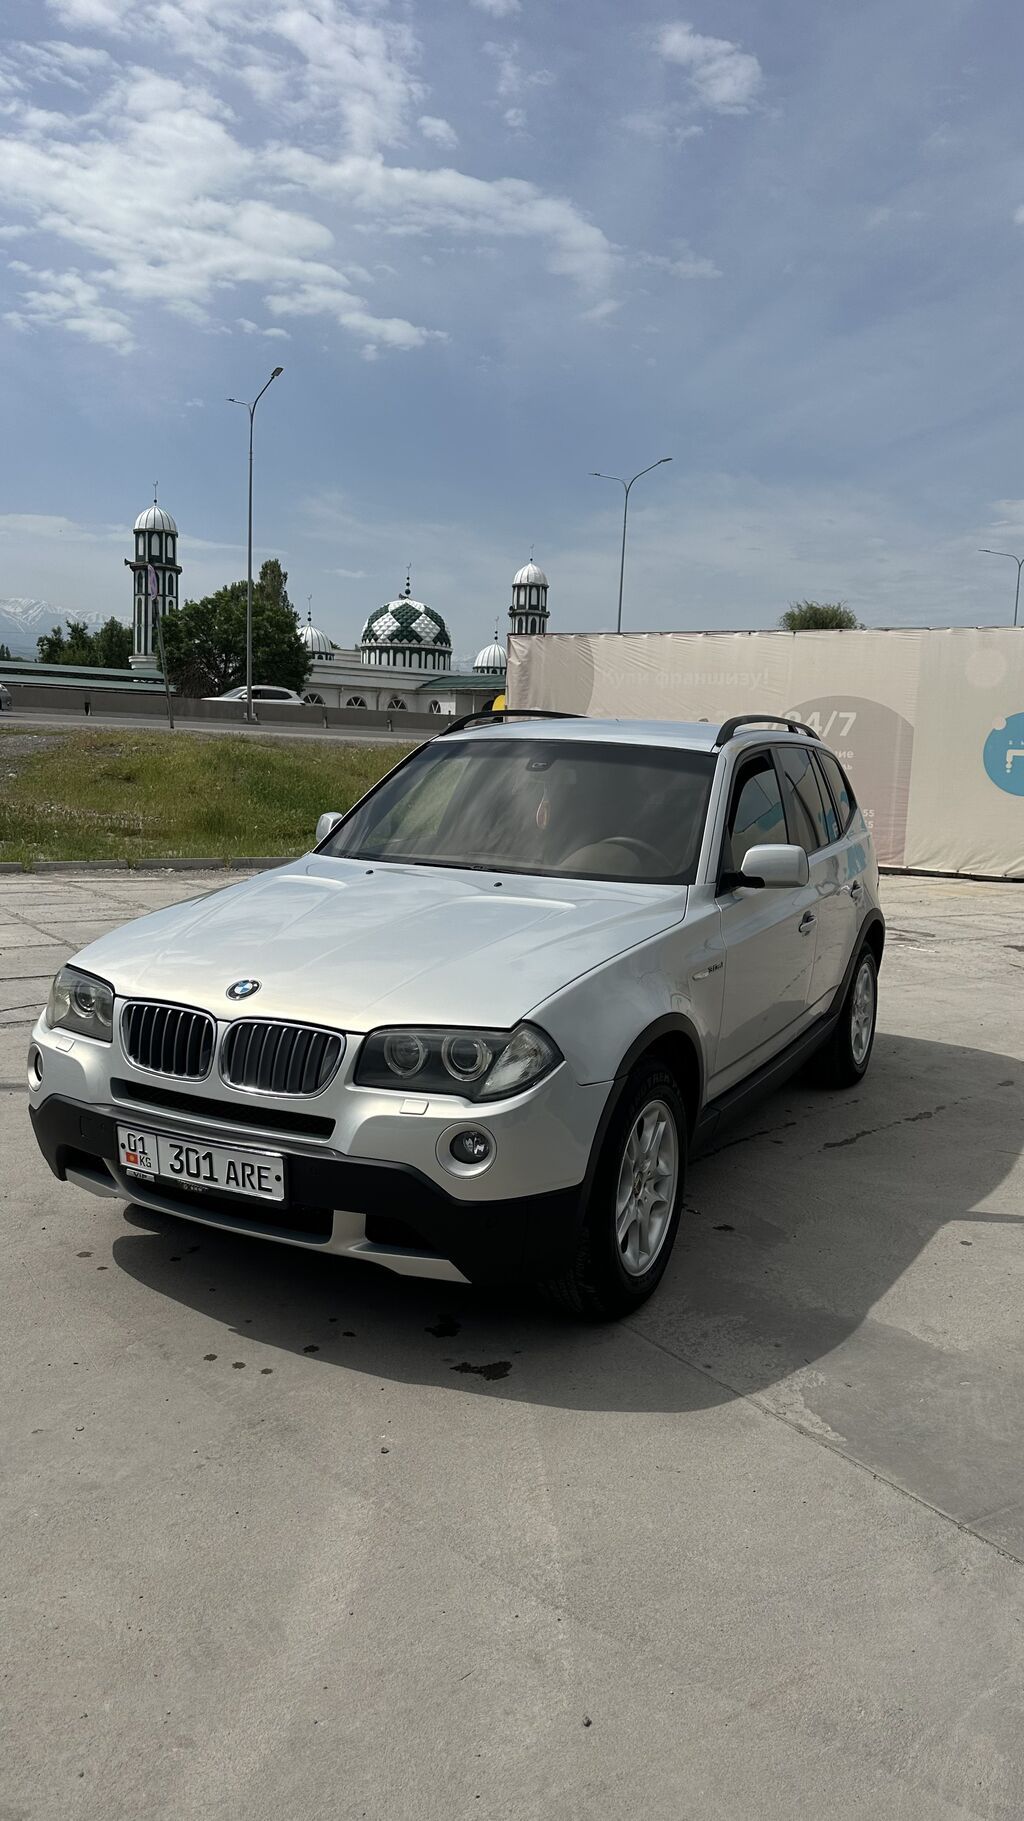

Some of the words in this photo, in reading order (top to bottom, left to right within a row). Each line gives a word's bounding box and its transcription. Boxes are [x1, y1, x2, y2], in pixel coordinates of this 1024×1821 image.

[655, 667, 768, 690] франшизу!
[127, 1132, 148, 1155] 01
[139, 1155, 152, 1168] KG
[169, 1143, 219, 1182] 301
[225, 1160, 272, 1192] ARE
